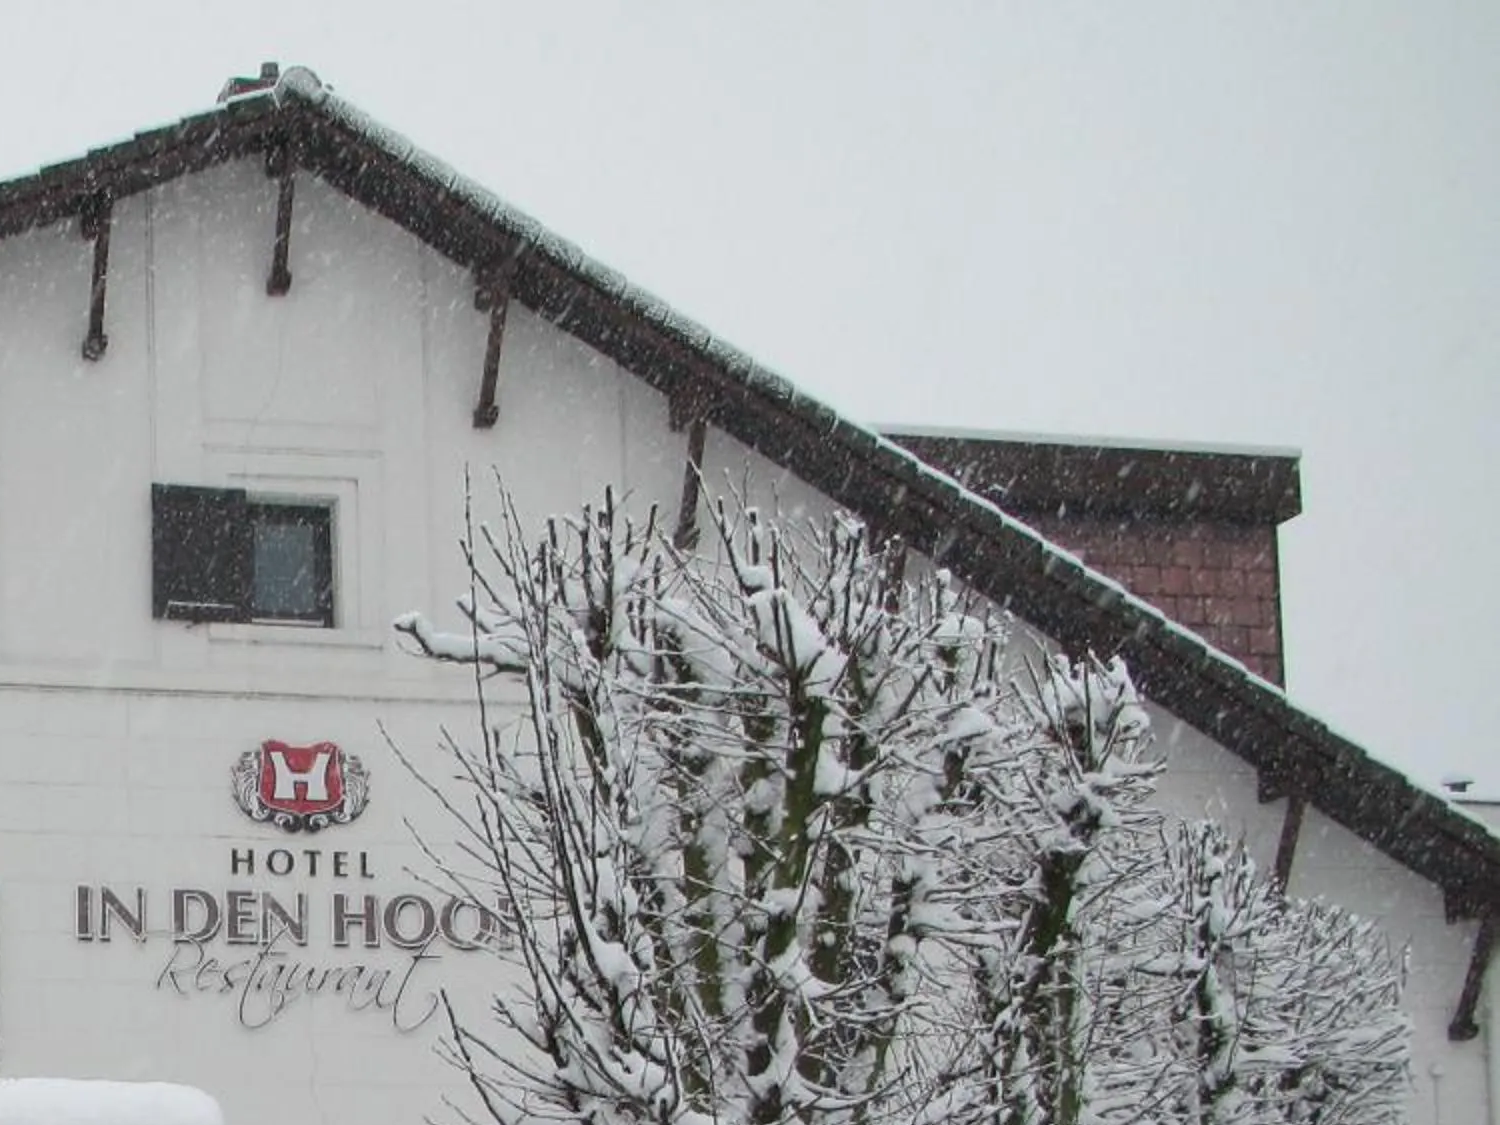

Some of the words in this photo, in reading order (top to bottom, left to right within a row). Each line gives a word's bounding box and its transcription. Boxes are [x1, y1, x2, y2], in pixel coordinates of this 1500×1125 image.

[230, 848, 375, 879] HOTEL
[75, 885, 145, 942] IN
[172, 887, 308, 946] DEN
[140, 926, 440, 1031] Restaurant
